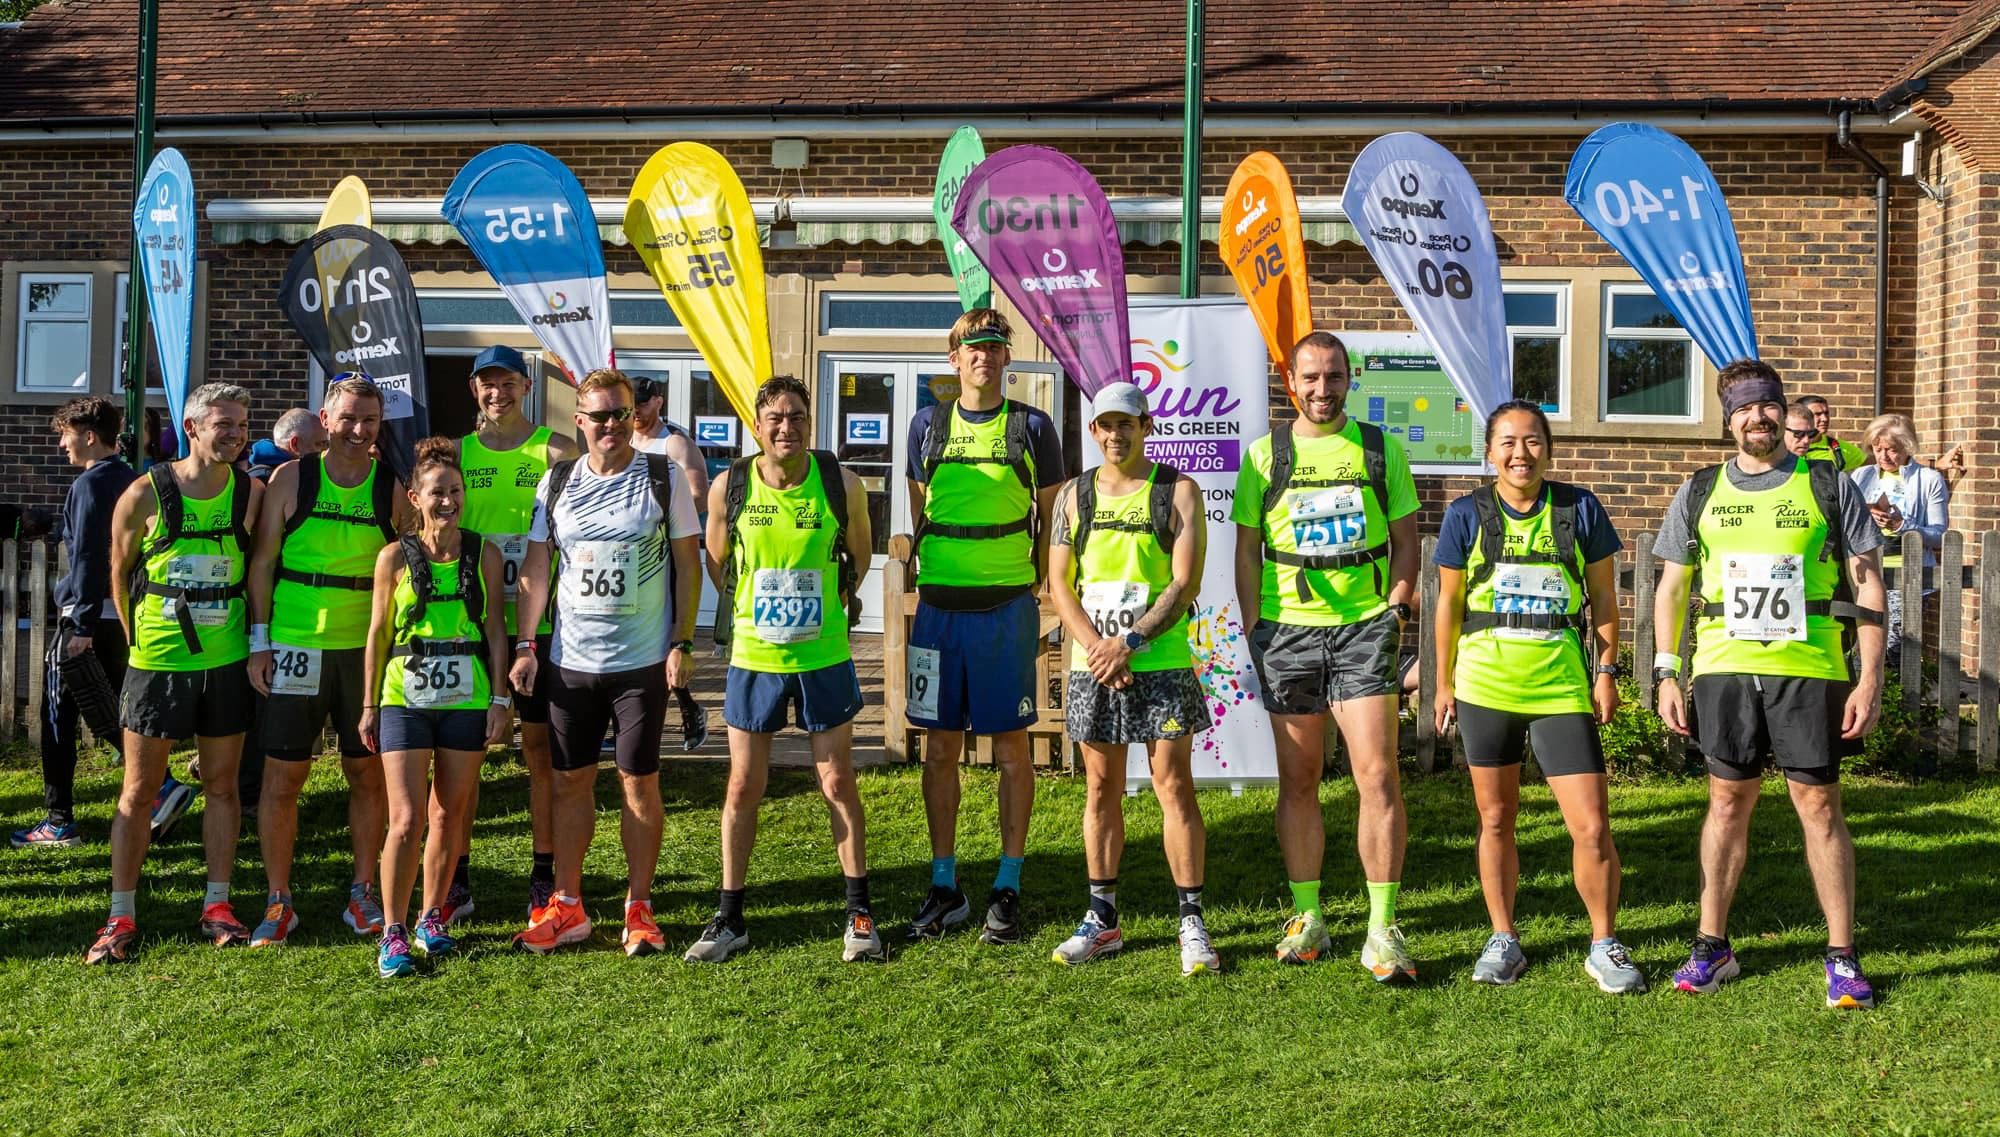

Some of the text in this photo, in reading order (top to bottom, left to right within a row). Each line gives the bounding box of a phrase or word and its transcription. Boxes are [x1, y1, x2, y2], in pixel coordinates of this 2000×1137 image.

[1131, 362, 1240, 418] Run
[1178, 421, 1240, 435] GREEN
[948, 436, 976, 444] ACER
[1144, 442, 1218, 457] ENNINGS
[1193, 457, 1224, 470] JOG
[466, 467, 498, 477] PACER
[515, 466, 540, 478] Run
[1293, 466, 1317, 475] CER
[1334, 466, 1364, 479] Run
[471, 477, 493, 488] 1:35
[744, 505, 779, 514] PACER
[794, 506, 821, 518] Run
[1093, 511, 1115, 519] CER
[1711, 505, 1754, 515] PACER
[1771, 504, 1809, 517] Run
[749, 516, 773, 526] 55:00
[1720, 517, 1742, 527] 1:40
[1296, 512, 1362, 547] 2515
[581, 568, 626, 597] 563
[1734, 587, 1790, 620] 576
[756, 597, 819, 627] 2392
[414, 661, 460, 690] 565
[909, 673, 928, 701] 19
